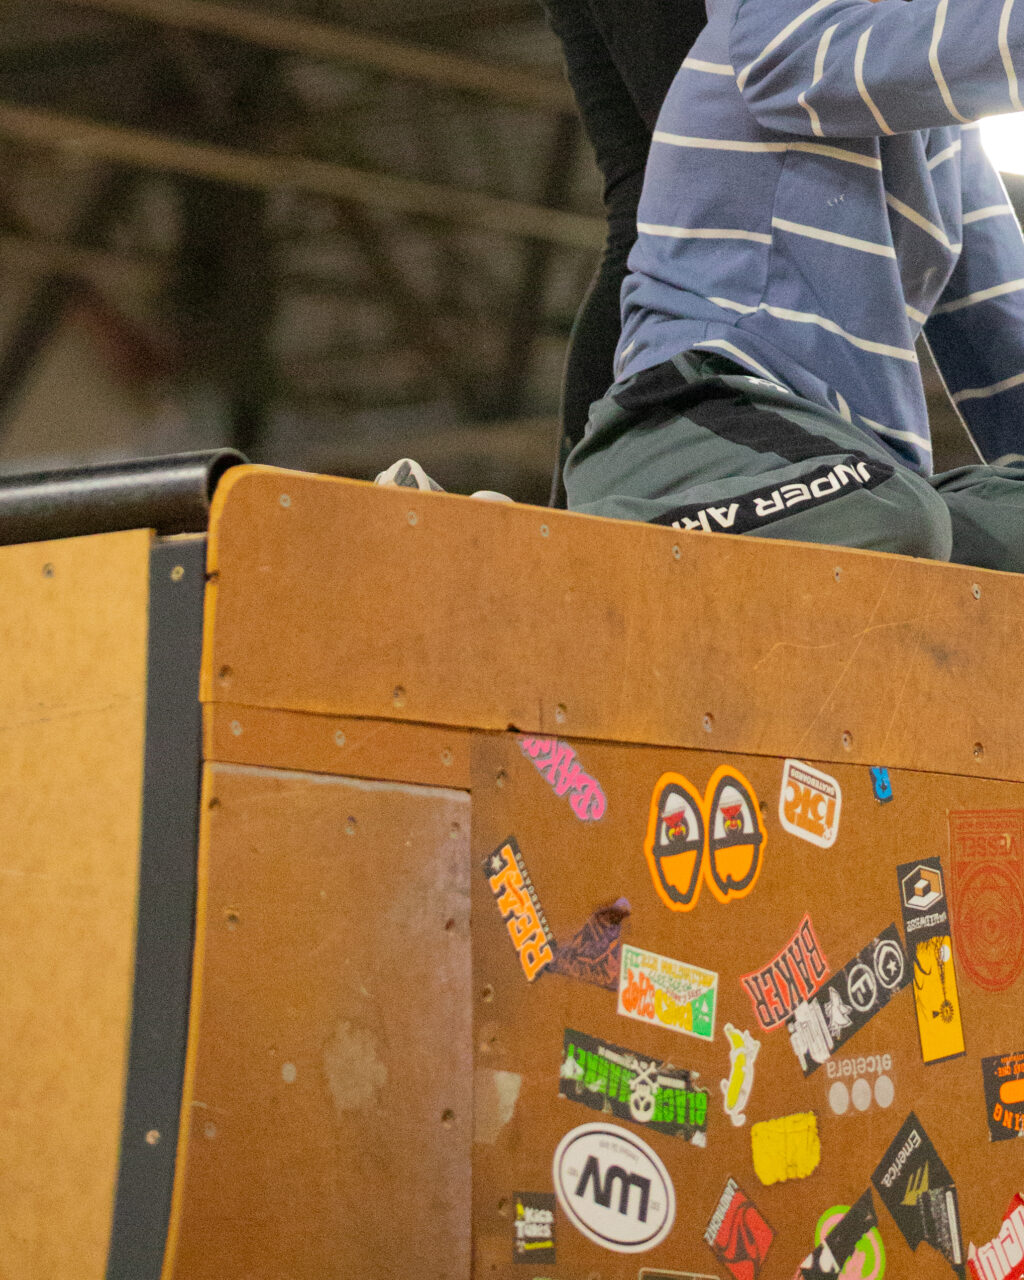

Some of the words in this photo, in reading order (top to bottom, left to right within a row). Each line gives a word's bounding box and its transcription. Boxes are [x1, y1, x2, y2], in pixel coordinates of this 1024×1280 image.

[742, 920, 826, 1024] BAKER
[827, 1053, 892, 1078] etcetera
[998, 1066, 1011, 1077] ONE
[881, 1129, 922, 1188] Emerica
